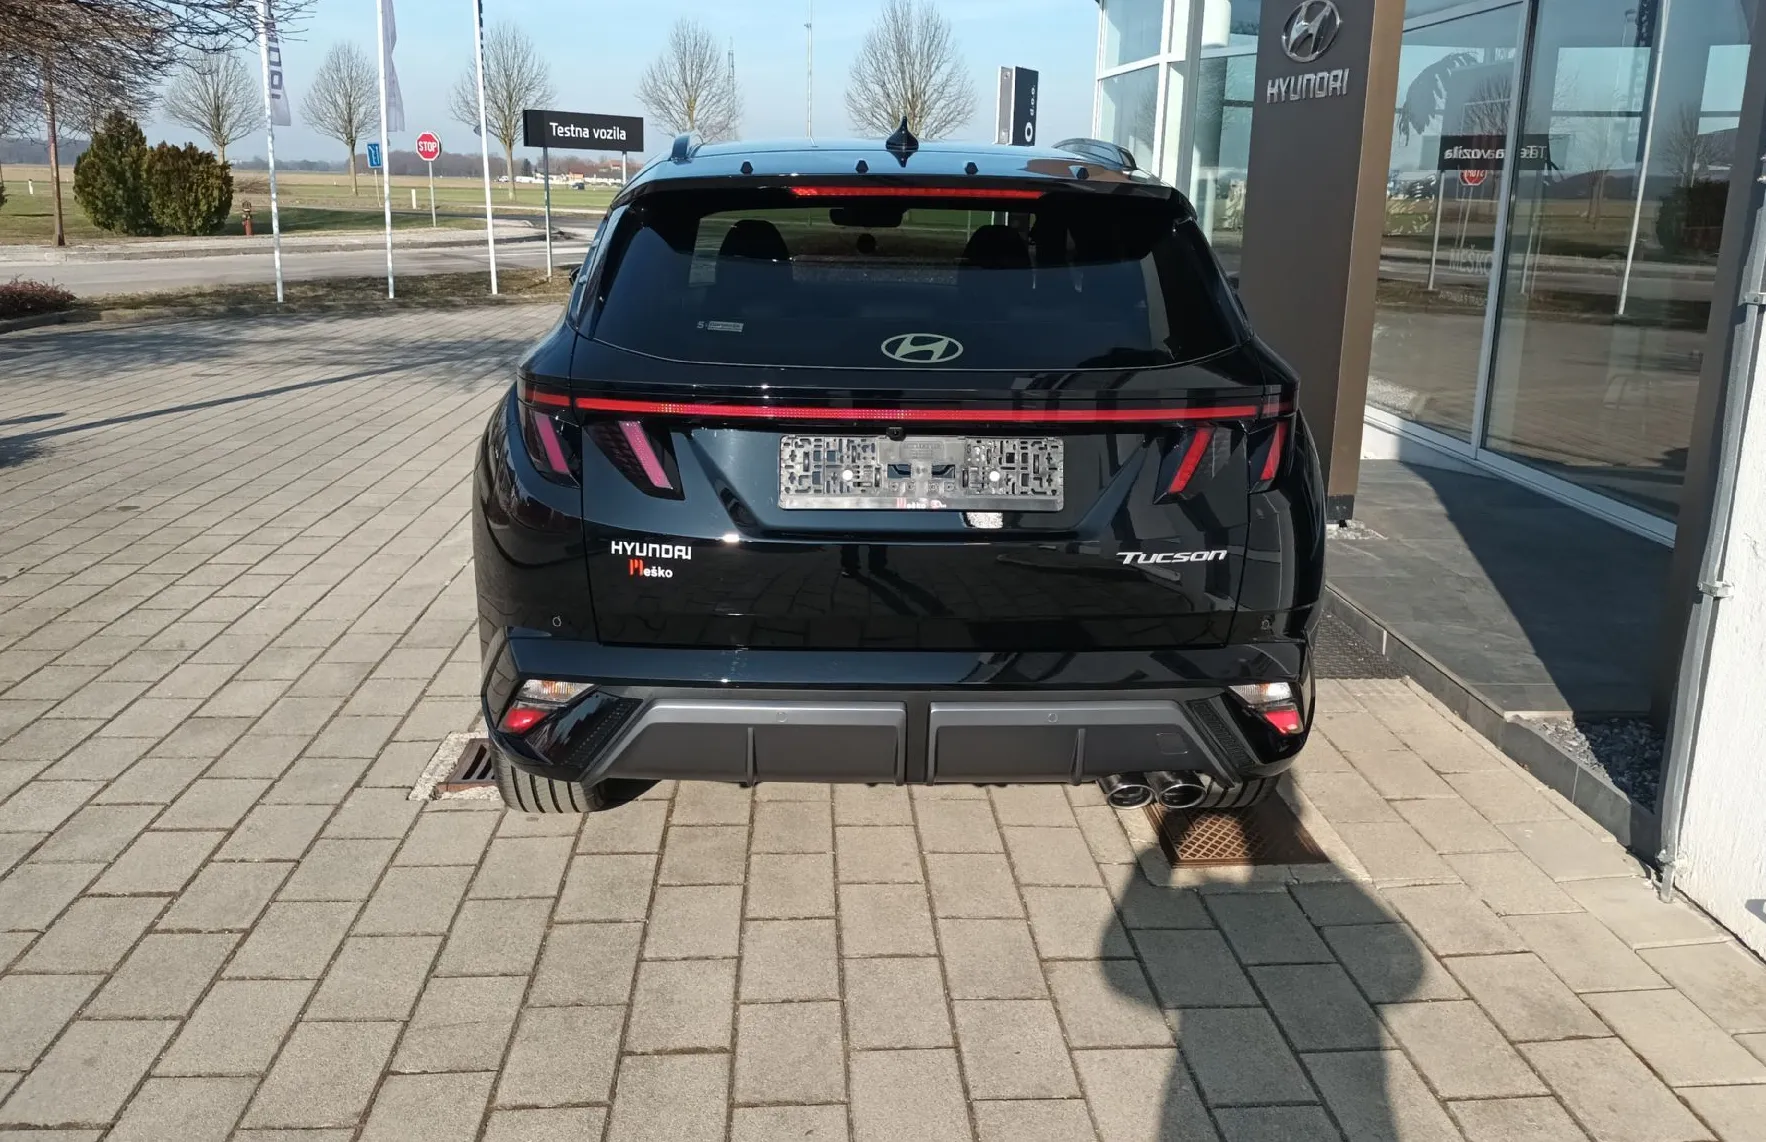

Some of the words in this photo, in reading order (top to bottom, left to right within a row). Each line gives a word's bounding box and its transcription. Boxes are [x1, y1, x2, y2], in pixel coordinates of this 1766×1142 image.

[1266, 67, 1350, 104] HYUNDAI
[549, 122, 590, 138] Testna
[593, 126, 627, 141] vozila
[418, 140, 438, 153] STOP
[611, 541, 692, 560] HYUNDAI
[629, 559, 673, 578] Meško
